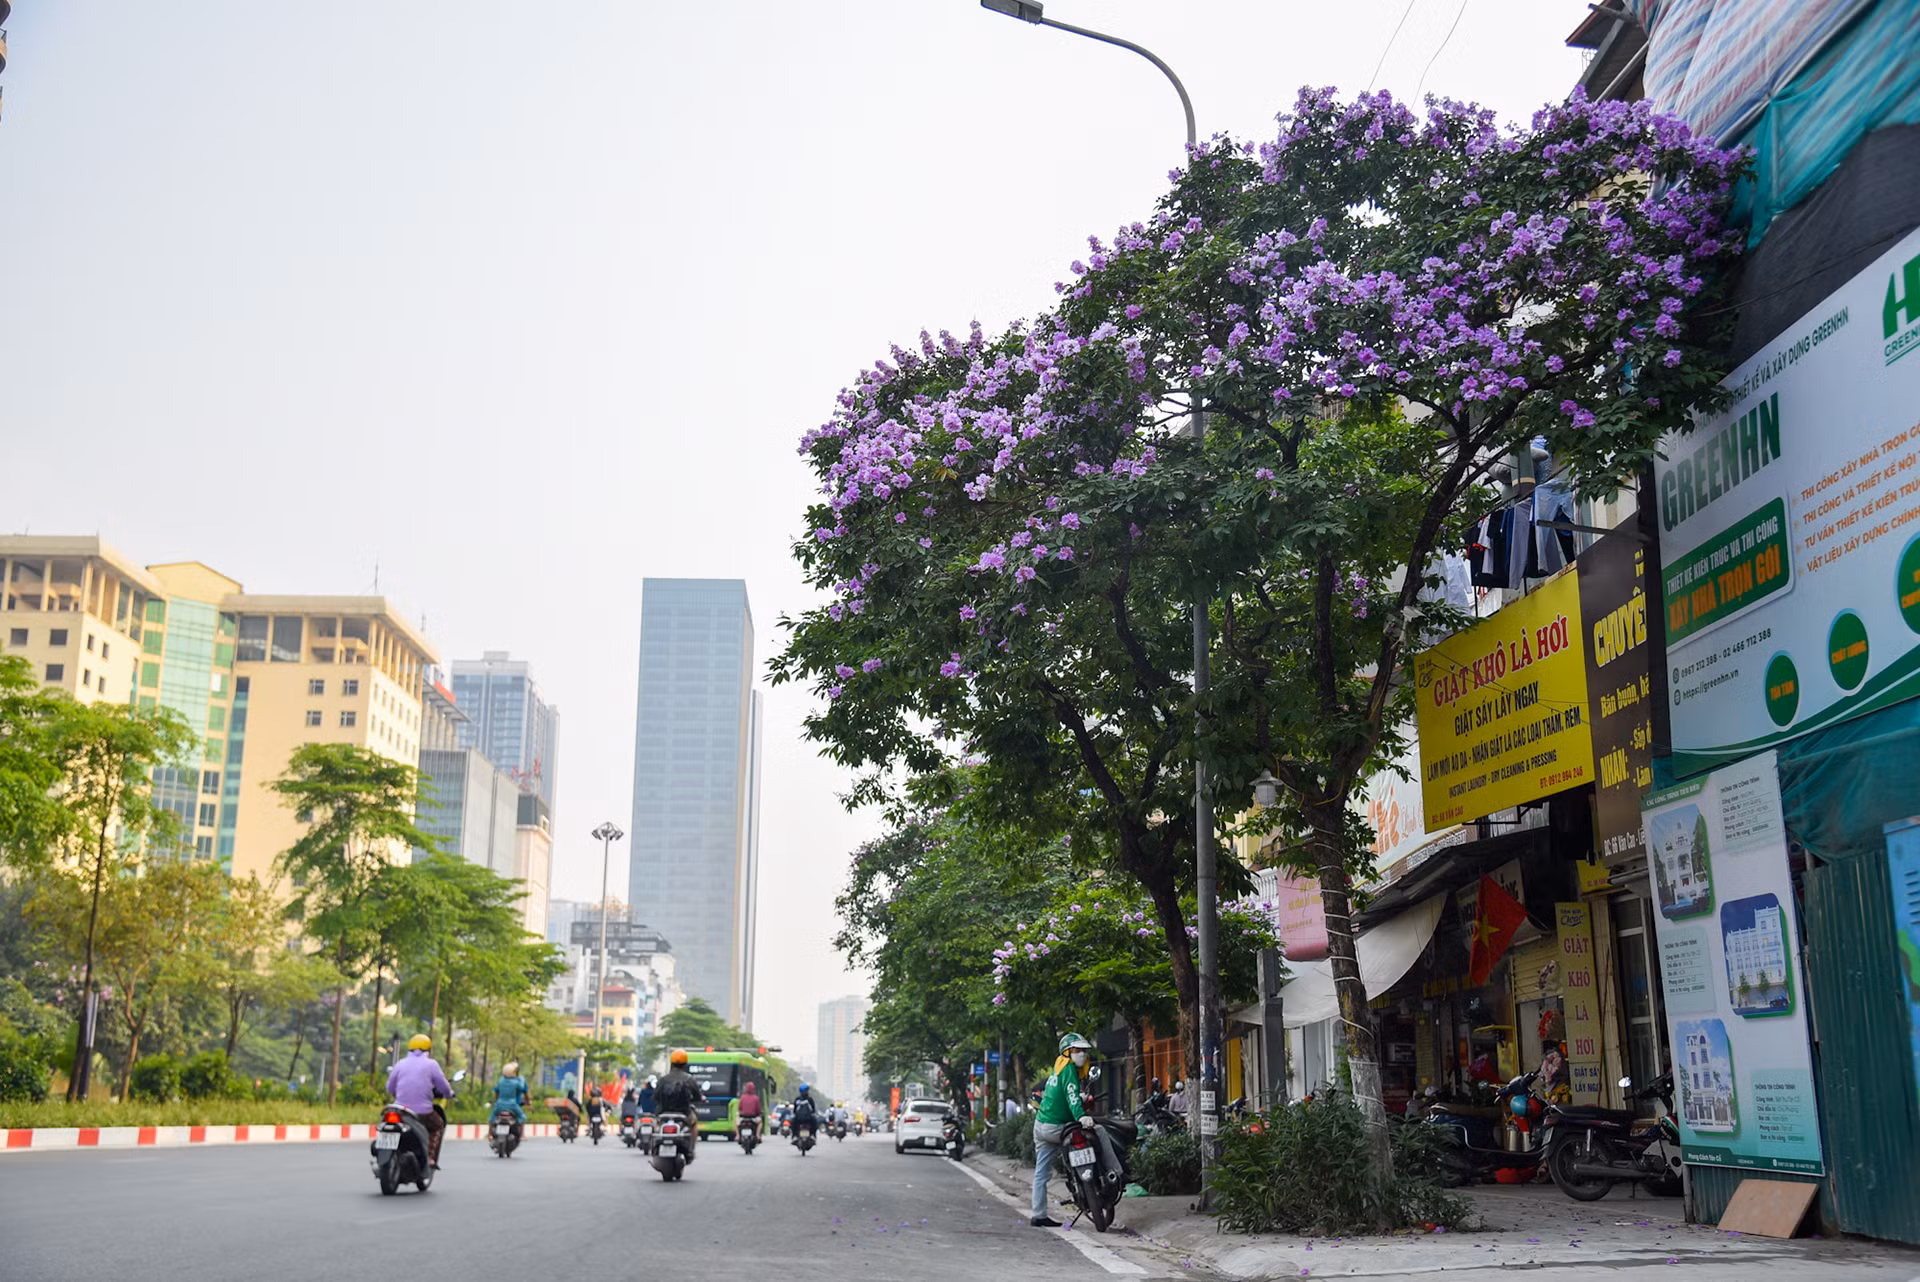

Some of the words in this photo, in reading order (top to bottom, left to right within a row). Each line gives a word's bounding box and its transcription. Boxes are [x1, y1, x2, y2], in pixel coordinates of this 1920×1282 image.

[1760, 361, 1771, 384] VÀ
[1772, 352, 1787, 377] XÂY
[1789, 336, 1810, 365] DỰNG
[1812, 306, 1848, 347] GREENHN
[1662, 391, 1781, 532] GREENHN
[1801, 485, 1815, 501] THI
[1815, 471, 1839, 493] CÔNG
[1841, 459, 1858, 479] XÂY
[1860, 446, 1880, 467] NHÀ
[1880, 430, 1908, 455] TRỌN
[1803, 510, 1816, 525] THI
[1818, 495, 1841, 516] CÔNG
[1842, 486, 1855, 503] VÀ
[1856, 470, 1882, 495] THIẾT
[1884, 458, 1897, 480] KẾ
[1898, 452, 1917, 472] NỘI
[1836, 507, 1860, 531] THIẾT
[1861, 497, 1874, 518] KẾ
[1875, 489, 1898, 511] KIẾN
[1667, 571, 1682, 596] THIẾT
[1694, 556, 1709, 580] KIẾN
[1742, 529, 1754, 551] THI
[1755, 516, 1778, 543] CÔNG
[1807, 554, 1823, 573] VẬT
[1824, 544, 1843, 563] LIỆU
[1844, 534, 1861, 554] XÂY
[1863, 522, 1888, 544] DỰNG
[1692, 576, 1716, 619] NHÀ
[1718, 559, 1752, 604] TRỌN
[1755, 543, 1780, 585] GÓI
[1594, 586, 1647, 668] CHUYÊ
[1723, 648, 1731, 658] 02
[1758, 628, 1771, 643] 388
[1434, 664, 1469, 708] GIẶT
[1472, 641, 1506, 690] KHÔ
[1510, 628, 1533, 672] LÀ
[1536, 614, 1569, 660] HƠI
[1455, 708, 1473, 737] GIẶT
[1476, 696, 1493, 728] SẤY
[1495, 687, 1511, 720] LẤY
[1514, 681, 1538, 711] NGAY
[1600, 693, 1617, 718] Bán
[1427, 761, 1439, 782] LÀM
[1490, 734, 1503, 759] GIẶT
[1504, 729, 1513, 752] LÀ
[1513, 725, 1526, 749] CÁC
[1527, 721, 1542, 745] LOẠI
[1501, 761, 1525, 779] CLEANING
[1531, 749, 1557, 769] PRESSING
[1600, 745, 1629, 790] NHẬN:
[1627, 831, 1635, 849] Cao
[1564, 933, 1589, 958] GIẶT
[1568, 966, 1591, 987] KHÔ
[1575, 1000, 1589, 1021] LÀ
[1575, 1036, 1595, 1055] HƠI
